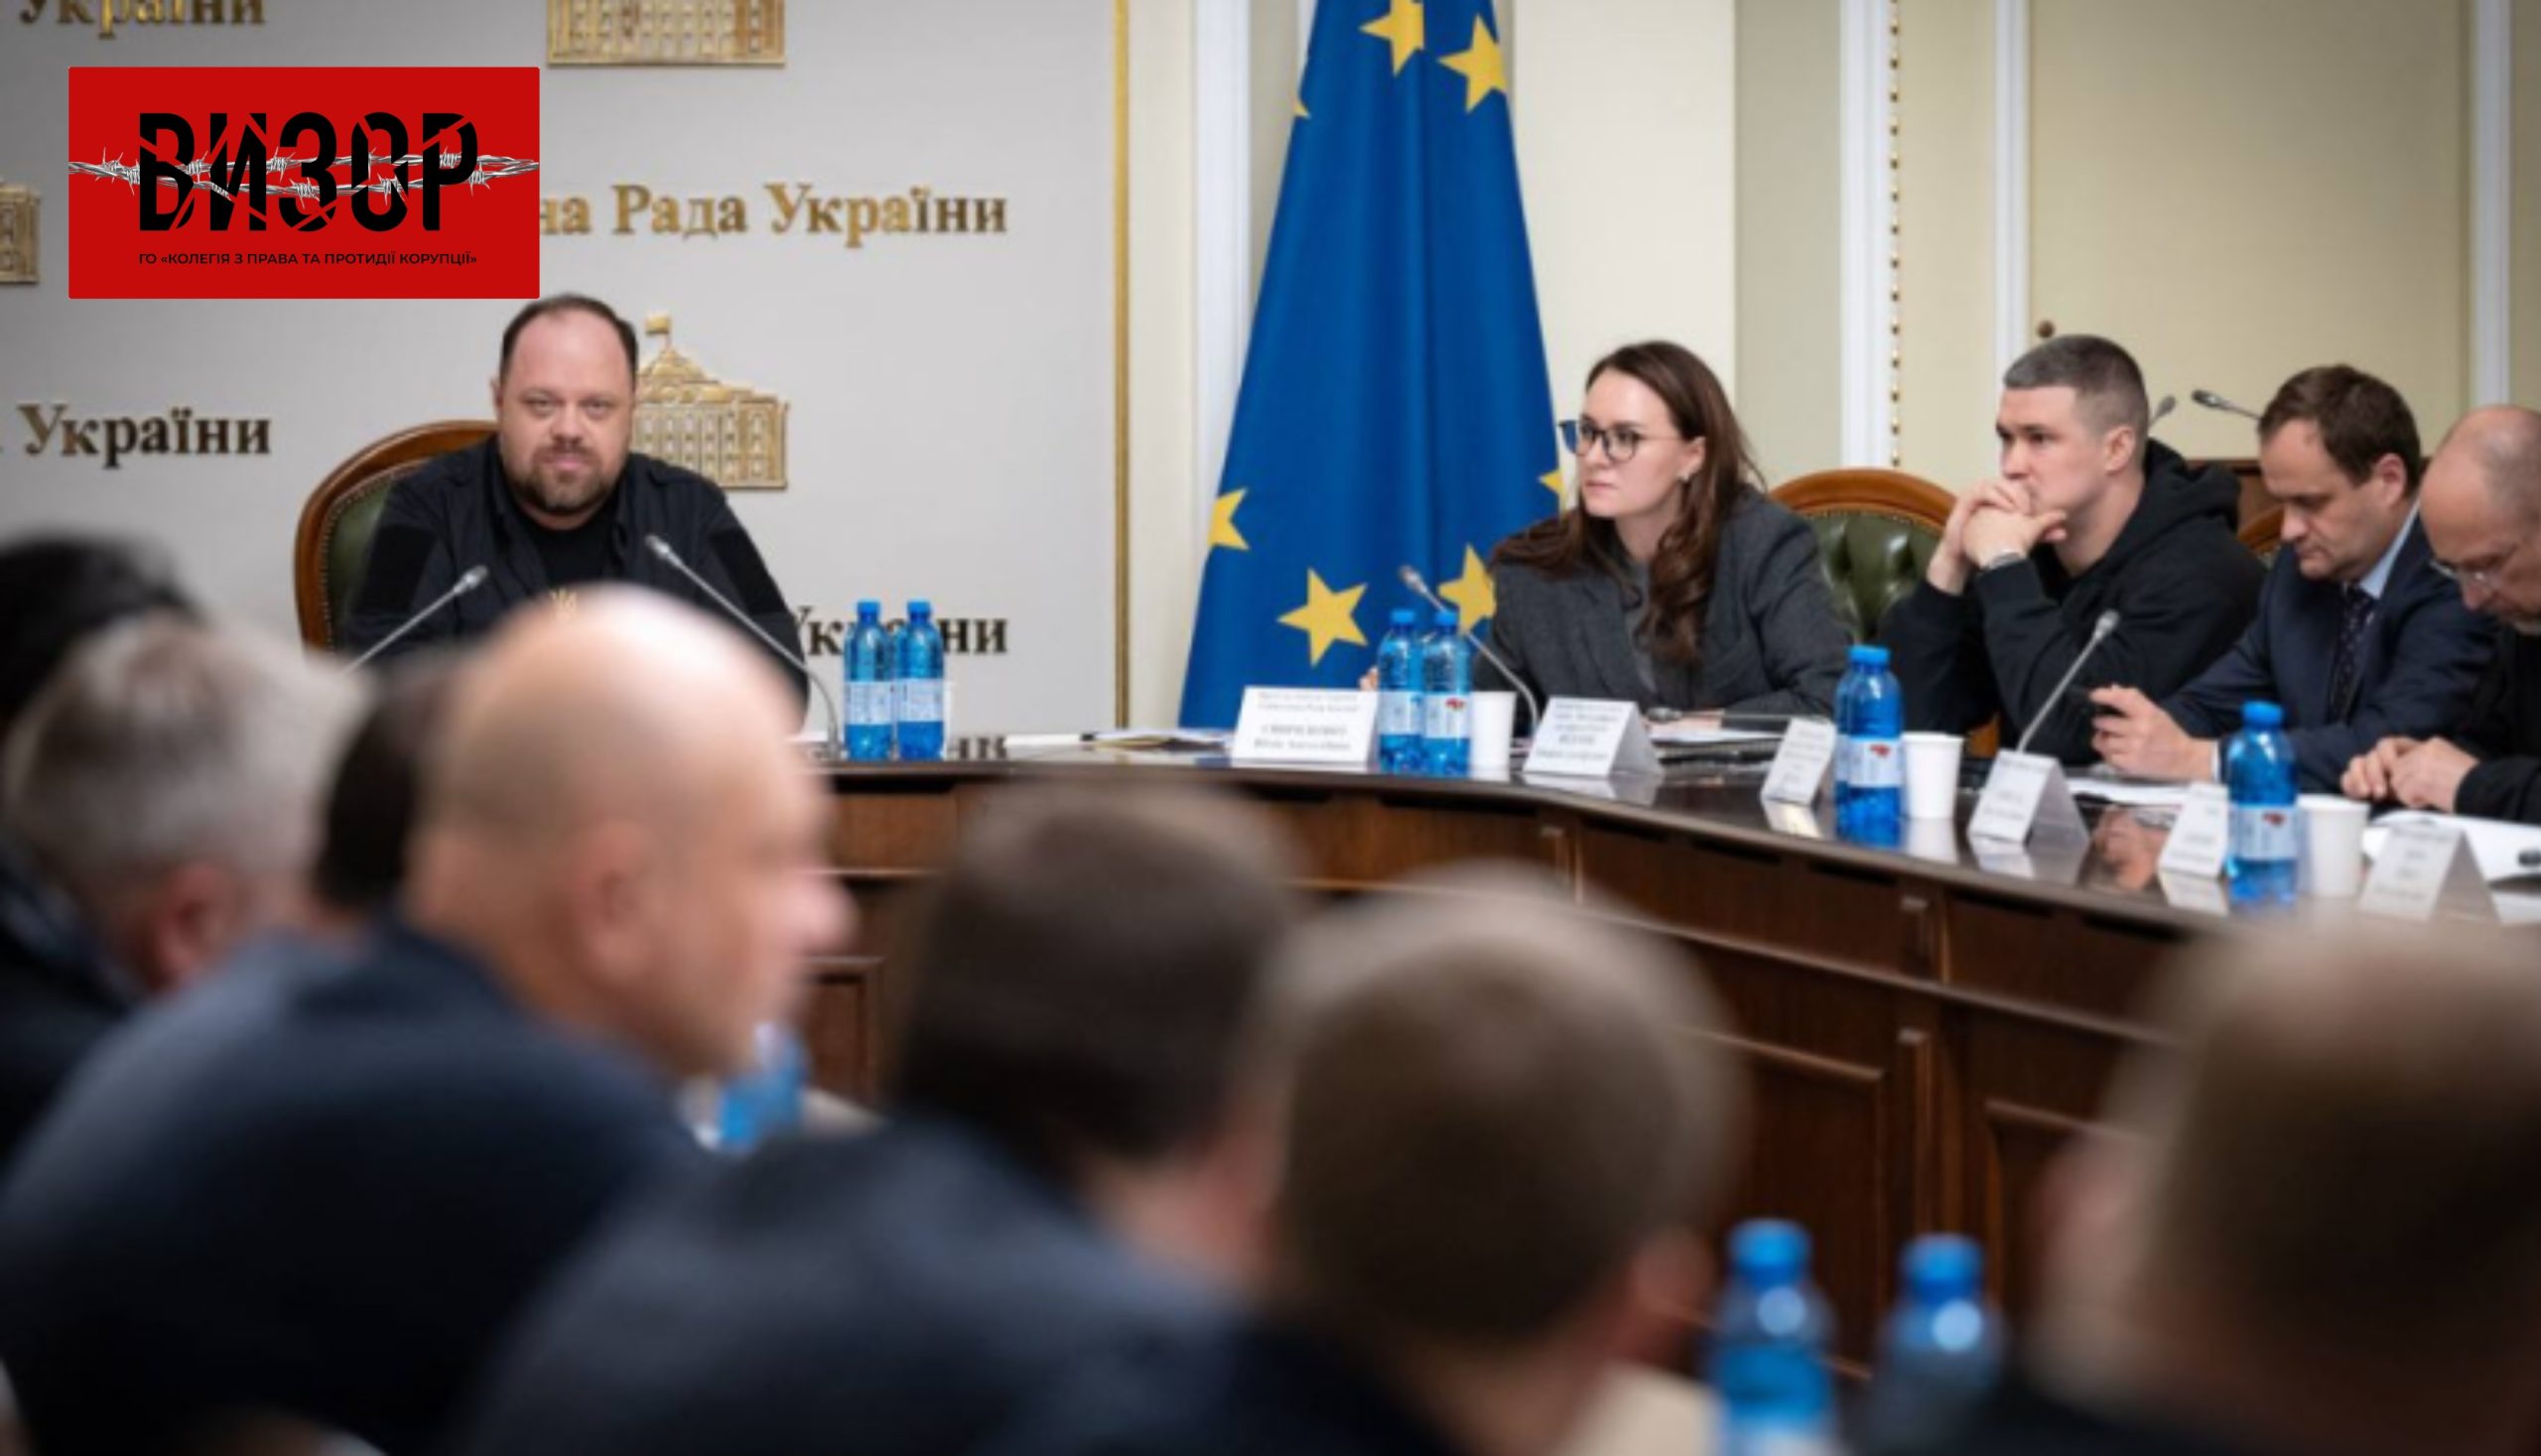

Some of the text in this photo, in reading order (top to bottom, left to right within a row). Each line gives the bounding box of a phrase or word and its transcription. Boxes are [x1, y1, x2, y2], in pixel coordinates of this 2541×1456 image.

[610, 184, 749, 240] Рада
[763, 183, 1007, 248] України
[18, 403, 271, 469] України
